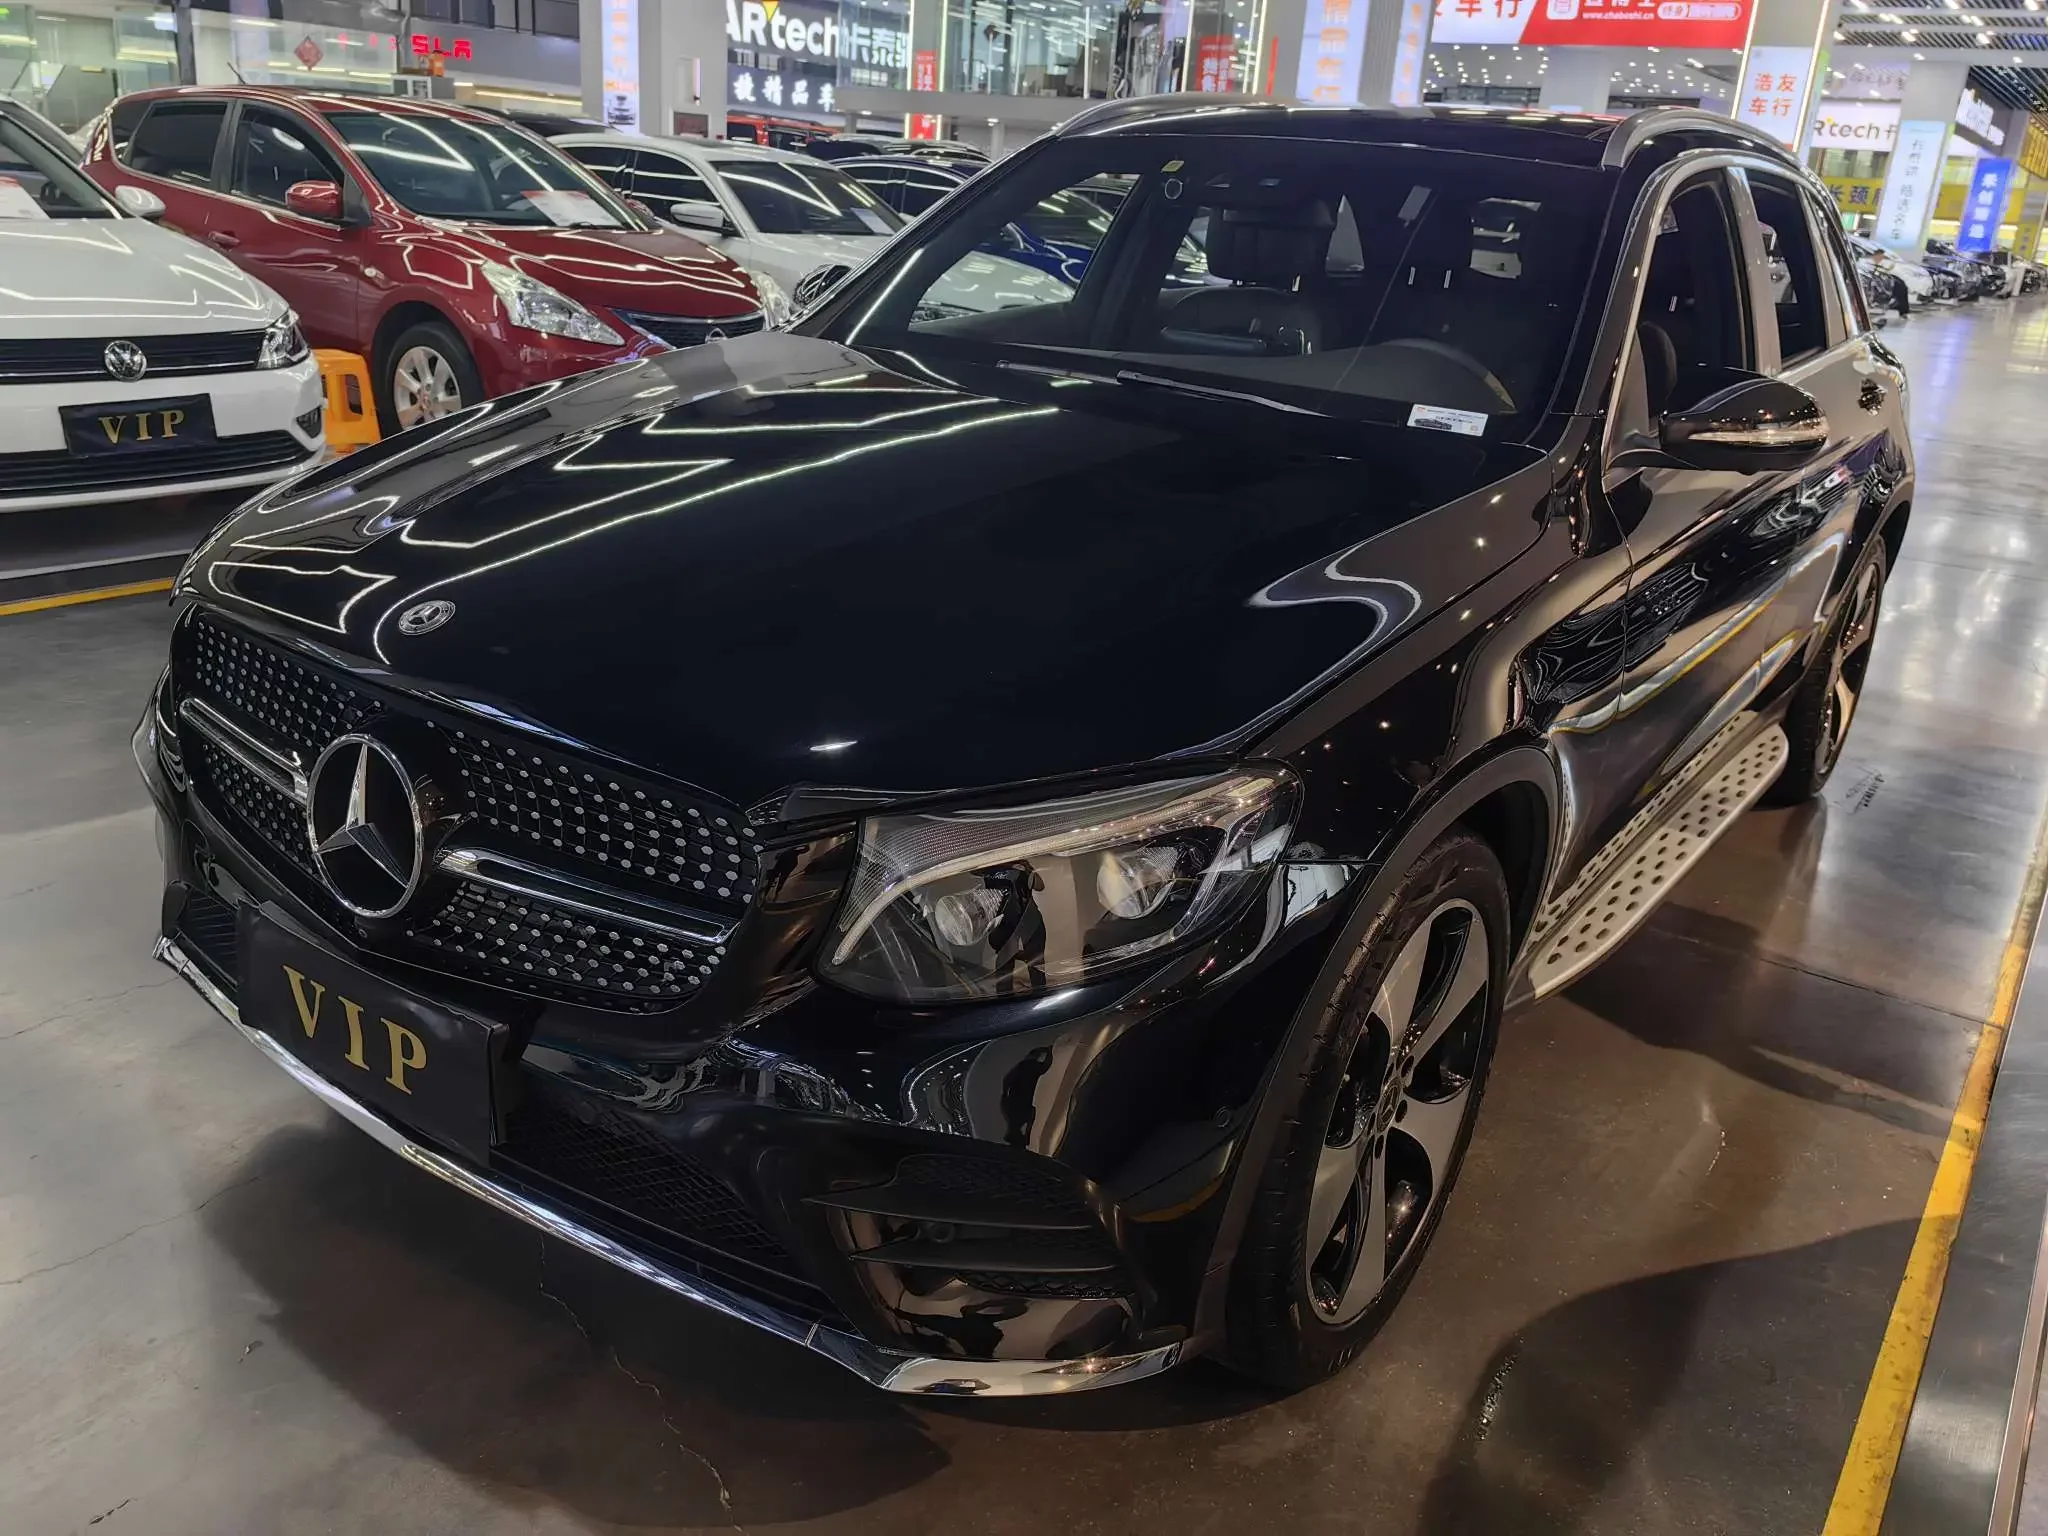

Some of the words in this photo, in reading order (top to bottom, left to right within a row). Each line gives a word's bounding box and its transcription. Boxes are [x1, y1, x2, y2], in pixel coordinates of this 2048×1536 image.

[1755, 73, 1798, 93] 浩友
[1749, 97, 1793, 117] 车行
[98, 410, 184, 444] VIP
[282, 964, 427, 1095] VIP
